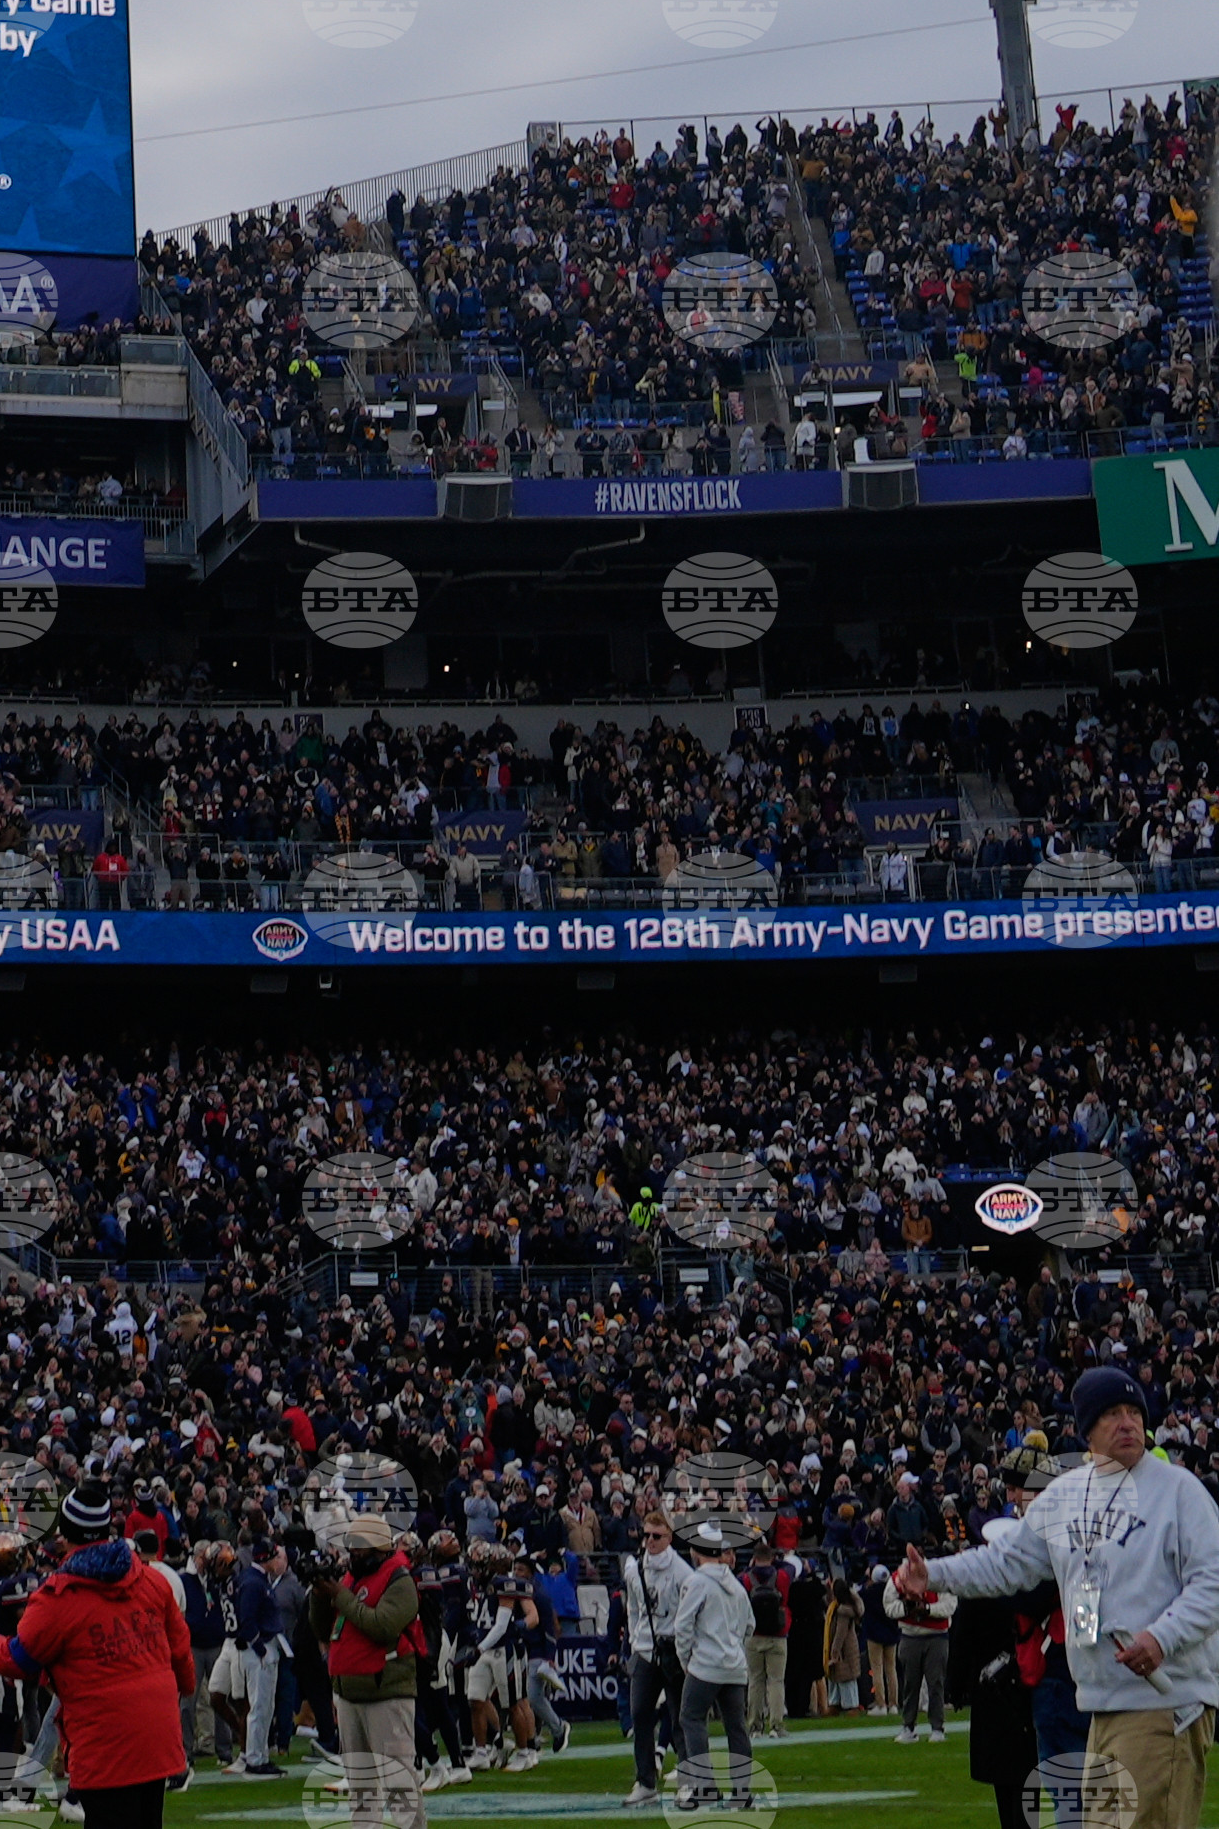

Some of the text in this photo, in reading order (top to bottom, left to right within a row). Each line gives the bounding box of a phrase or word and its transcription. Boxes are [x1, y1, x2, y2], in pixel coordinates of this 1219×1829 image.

[0, 22, 37, 57] by
[595, 479, 742, 512] #RAVENSFLOCK
[445, 824, 506, 842] NAVY
[874, 812, 937, 832] NAVY
[22, 919, 121, 952] USAA
[265, 925, 294, 935] ARMY
[348, 901, 1219, 953] Welcome to the 126th Army-Navy Game presente
[267, 938, 295, 948] NAVY
[991, 1192, 1026, 1204] ARMY
[993, 1208, 1027, 1219] NAVY
[114, 1329, 131, 1345] 12
[1066, 1507, 1147, 1555] NAVY
[554, 1648, 597, 1674] UKE
[549, 1675, 619, 1702] ANNO
